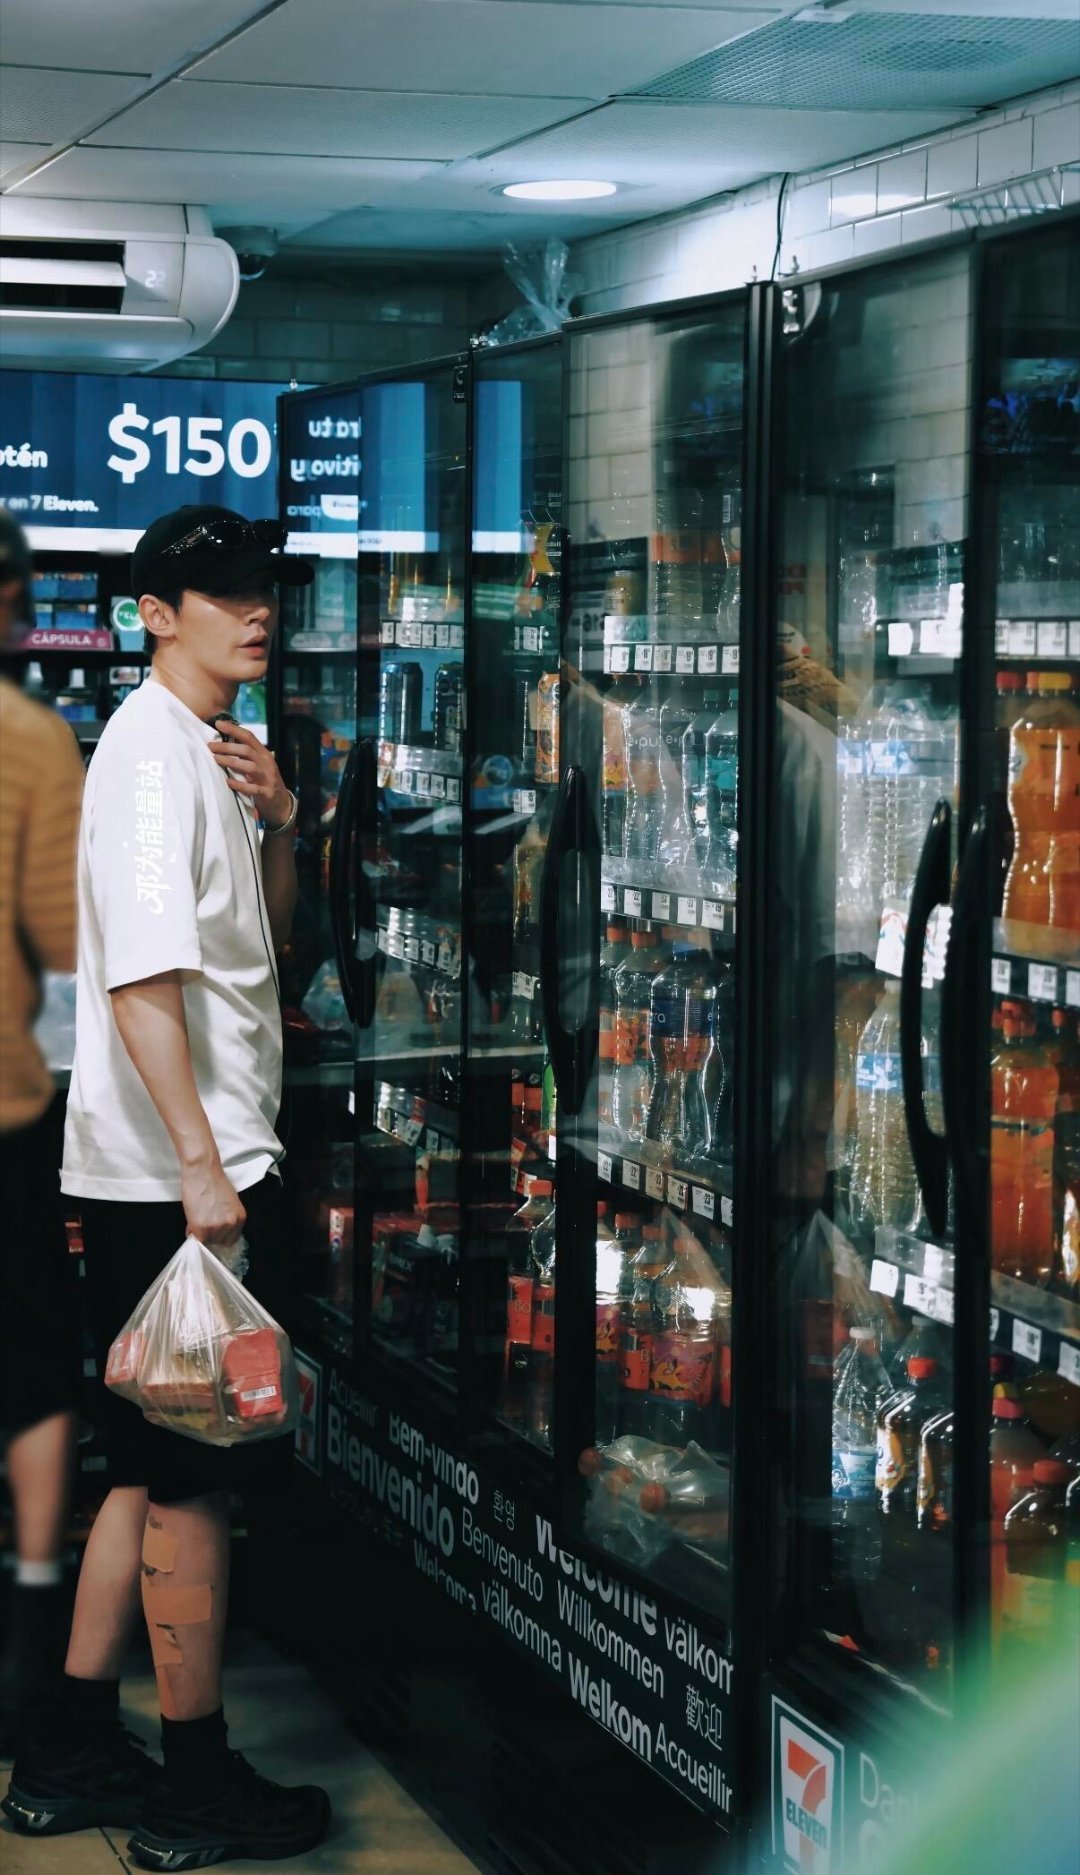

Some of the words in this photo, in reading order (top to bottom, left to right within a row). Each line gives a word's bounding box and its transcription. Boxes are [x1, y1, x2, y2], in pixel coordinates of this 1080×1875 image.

[107, 402, 272, 484] $150
[30, 494, 42, 511] 7
[31, 632, 92, 646] CÁPSULA
[327, 1403, 455, 1557] Bienvenido
[462, 1506, 544, 1602] Benvenuto
[482, 1579, 562, 1673] välkomna
[557, 1578, 665, 1698] Willkommen
[567, 1652, 652, 1762] Welkom
[685, 1683, 724, 1752] 歡迎
[655, 1721, 733, 1814] Accueillir
